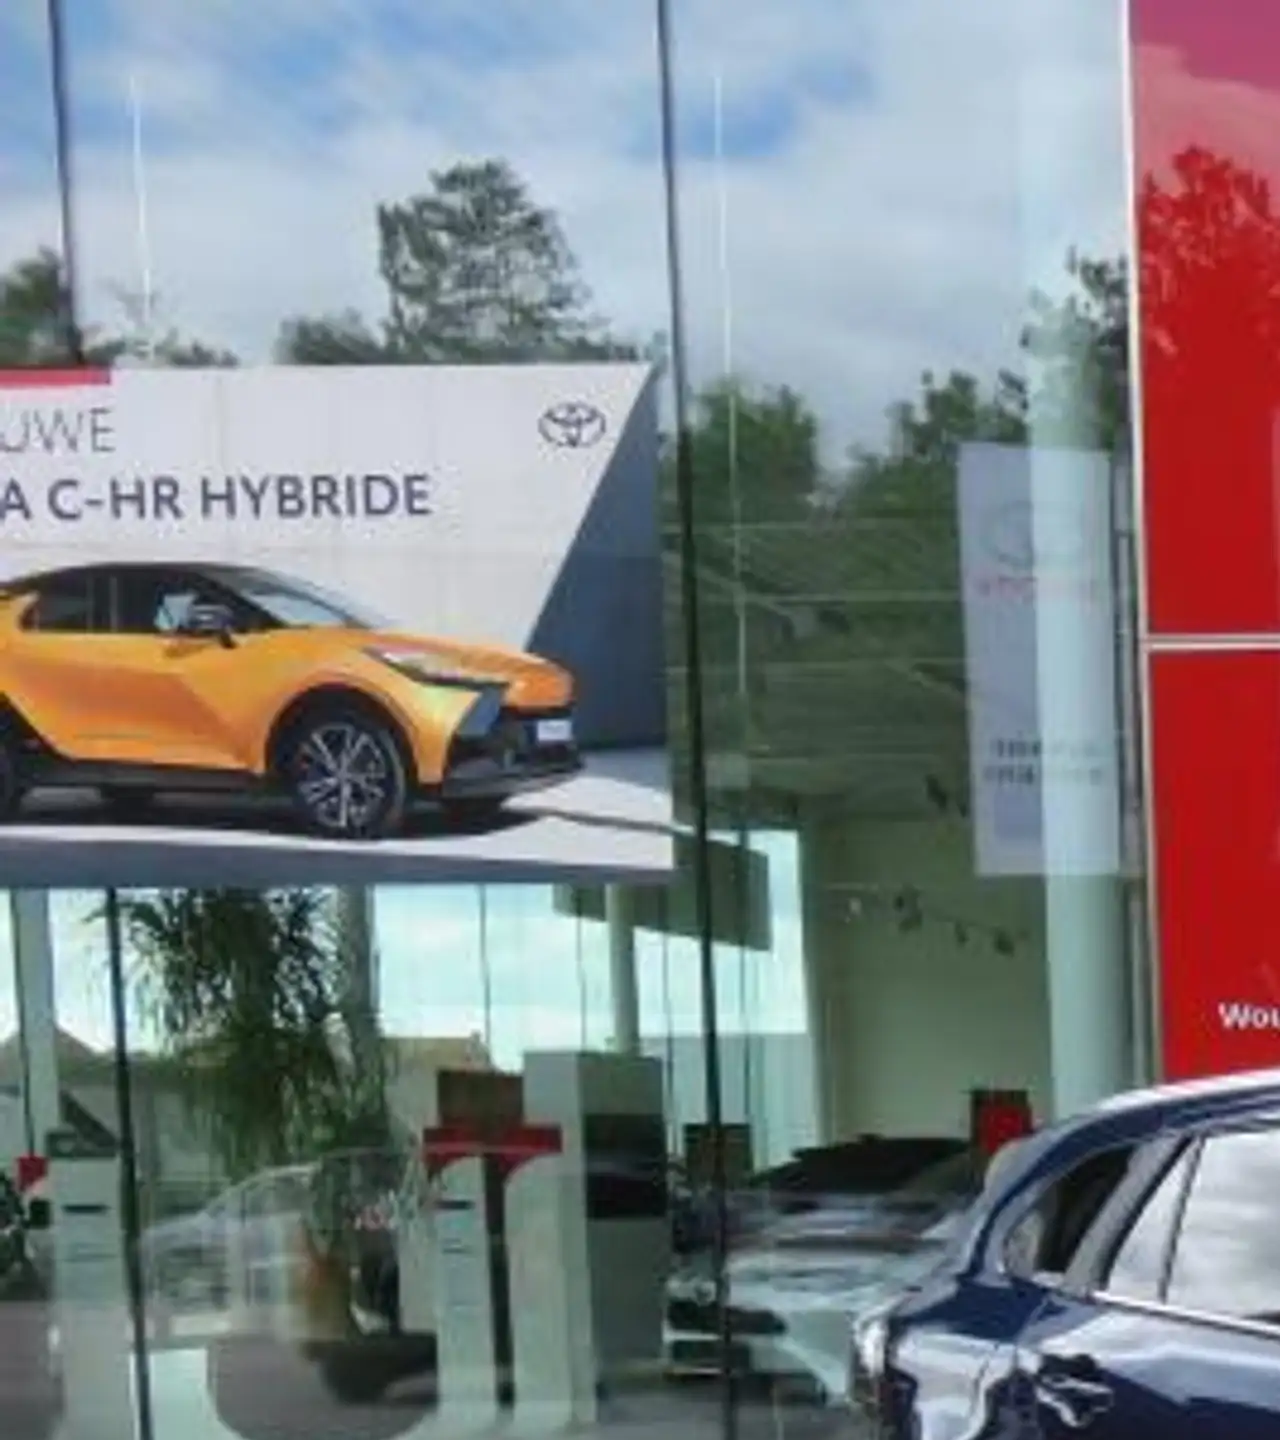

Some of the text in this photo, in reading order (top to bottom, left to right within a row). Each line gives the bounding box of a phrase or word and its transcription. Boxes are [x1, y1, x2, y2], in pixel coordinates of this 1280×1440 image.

[0, 473, 435, 522] A C-HR HYBRIDE
